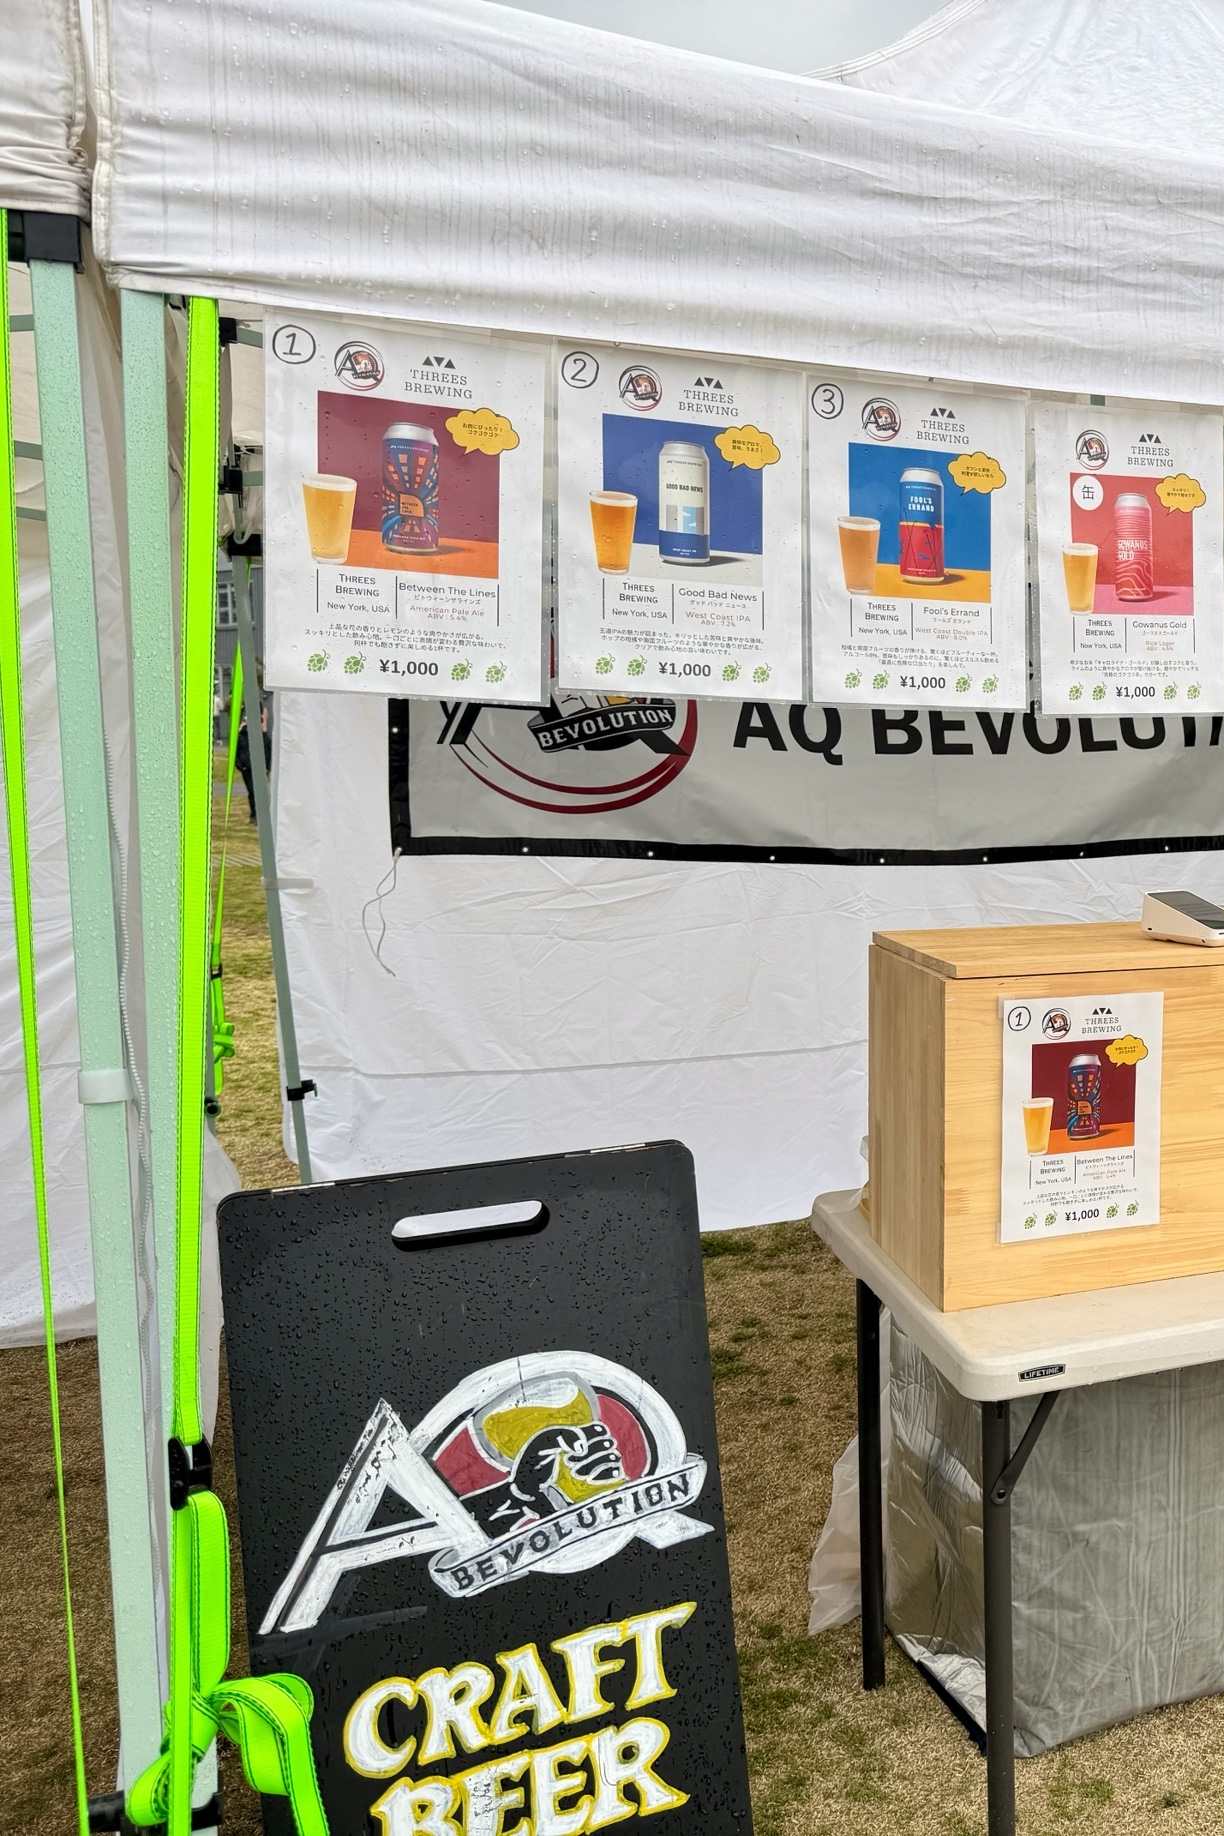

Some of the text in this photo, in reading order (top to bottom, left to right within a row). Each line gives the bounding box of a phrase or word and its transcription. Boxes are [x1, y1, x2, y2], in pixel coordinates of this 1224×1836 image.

[409, 369, 467, 385] THREES
[404, 383, 473, 399] BREWING
[683, 389, 734, 404] THREES
[679, 401, 739, 417] BREWING
[921, 420, 965, 432] THREES
[916, 431, 969, 445] BREWING
[1131, 446, 1170, 457] THREES
[1128, 457, 1174, 468] BREWING
[1082, 484, 1095, 500] 缶
[339, 574, 376, 585] THREES
[335, 585, 380, 597] BREWING
[399, 583, 496, 598] Between The Lines
[623, 582, 655, 593] THREES
[619, 594, 658, 604] BREWING
[679, 588, 757, 602] Good Bad News
[327, 602, 390, 613] New York, USA
[410, 605, 449, 614] American
[868, 602, 896, 612] THREES
[923, 607, 980, 617] Fool's Errand
[612, 608, 667, 619] New York, USA
[685, 611, 751, 622] West Coast IPA
[865, 613, 899, 622] BREWING
[1088, 619, 1112, 627] THREES
[1133, 621, 1187, 629] Gowanus Gold
[858, 627, 874, 635] New
[875, 628, 890, 636] York,
[1085, 629, 1115, 637] BREWING
[379, 659, 438, 676] ¥1,000
[659, 662, 711, 678] ¥1,000
[900, 676, 946, 689] ¥1,000
[1116, 686, 1155, 698] ¥1,000
[538, 707, 673, 748] BEVOLUTION
[733, 701, 843, 766] AQ
[1085, 1017, 1119, 1025] THREES
[1081, 1025, 1122, 1034] BREWING
[1077, 1156, 1104, 1165] Between
[1065, 1209, 1099, 1222] ¥1,000
[1024, 1367, 1059, 1379] LIFETIME
[451, 1471, 692, 1590] BEVOLUTION
[343, 1601, 697, 1778] CRAFT
[370, 1717, 691, 1836] BEER
